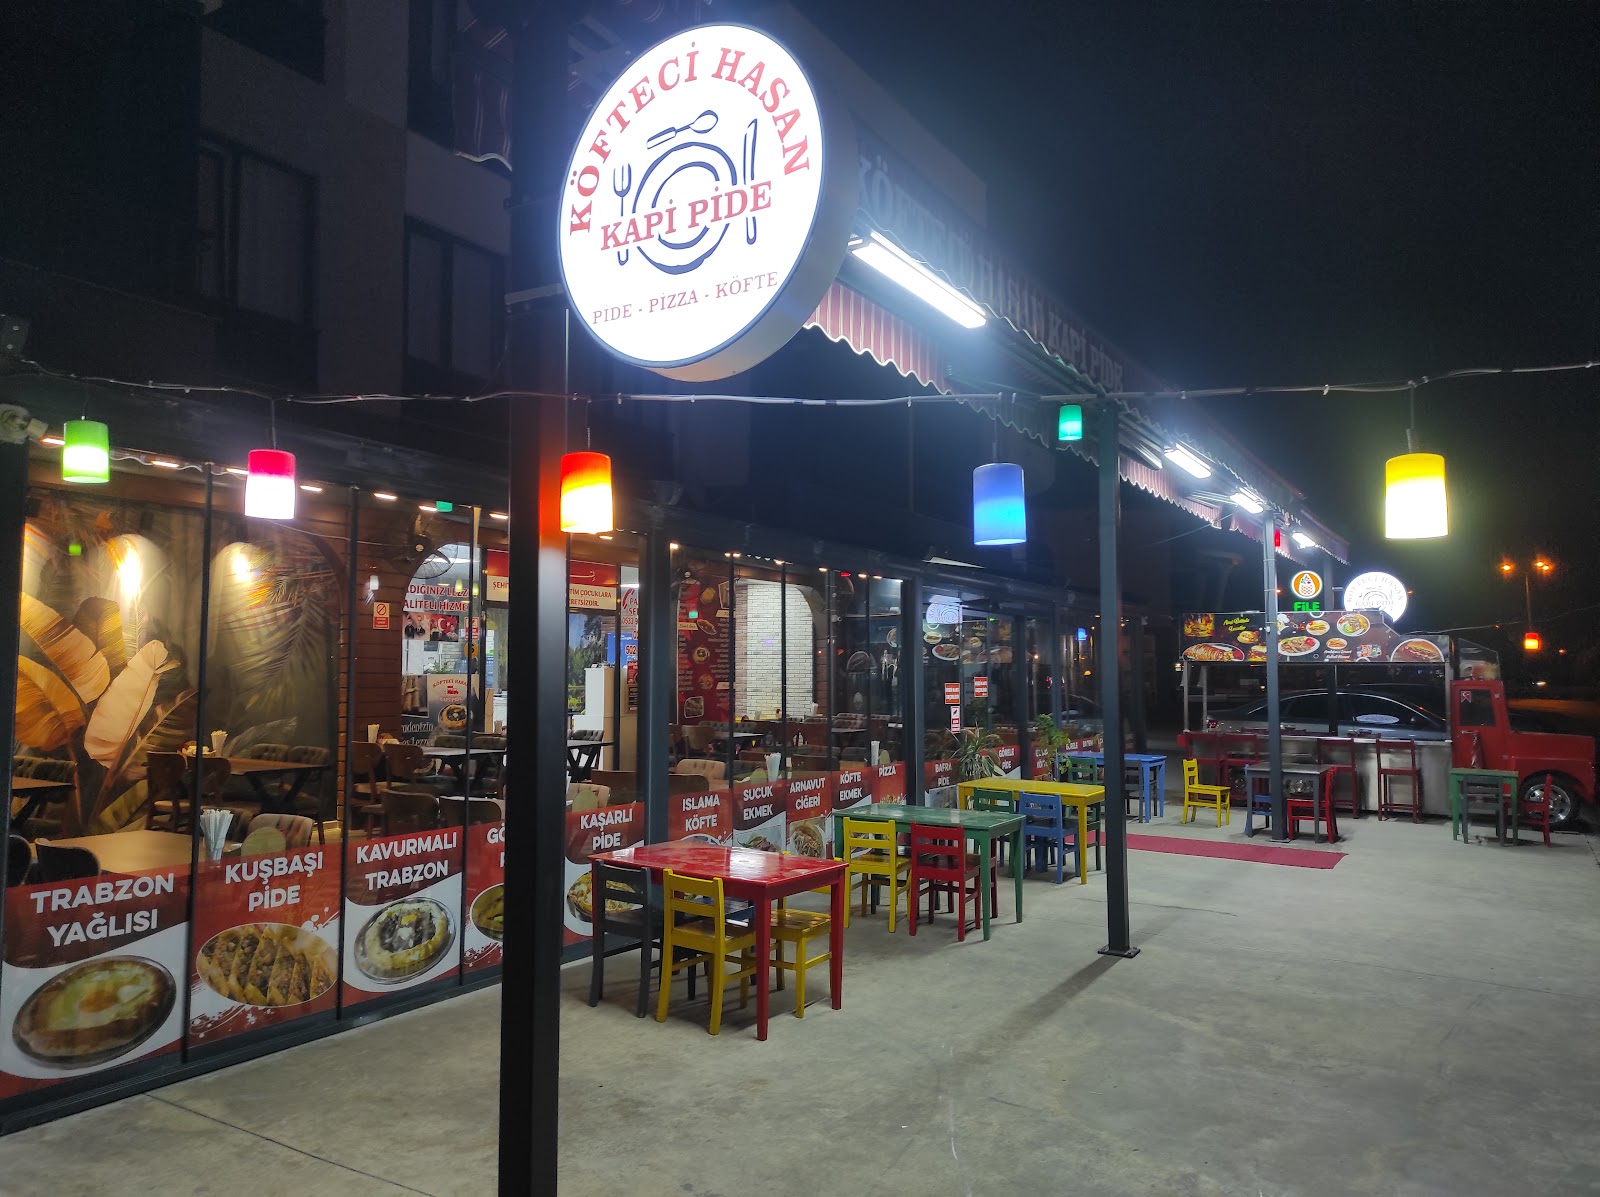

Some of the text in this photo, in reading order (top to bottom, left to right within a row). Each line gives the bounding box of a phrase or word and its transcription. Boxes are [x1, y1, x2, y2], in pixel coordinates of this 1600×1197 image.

[569, 41, 700, 236] KÖFTECİ
[712, 47, 811, 176] HASAN
[601, 180, 772, 251] KAPİ PİDE
[592, 303, 633, 324] PİDE
[649, 290, 699, 313] PİZZA
[715, 271, 779, 299] KÖFTE
[439, 600, 469, 612] HİZME
[839, 771, 862, 785] KÖFTE
[878, 764, 897, 777] PİZZA
[743, 785, 774, 802] SUCUK
[789, 777, 826, 794] ARNAVUT
[839, 787, 863, 801] EKMEK
[682, 794, 721, 812] ISLAMA
[743, 803, 774, 821] EKMEK
[580, 808, 633, 830] KAŞARLI
[685, 813, 718, 832] KÖFTE
[356, 831, 457, 864] KAVURMALI
[592, 832, 622, 850] PİDE
[225, 851, 324, 885] KUŞBAŞI
[365, 859, 449, 891] TRABZON
[30, 872, 175, 914] TRABZON
[248, 885, 301, 912] PİDE
[47, 908, 158, 948] YAĞLISI
